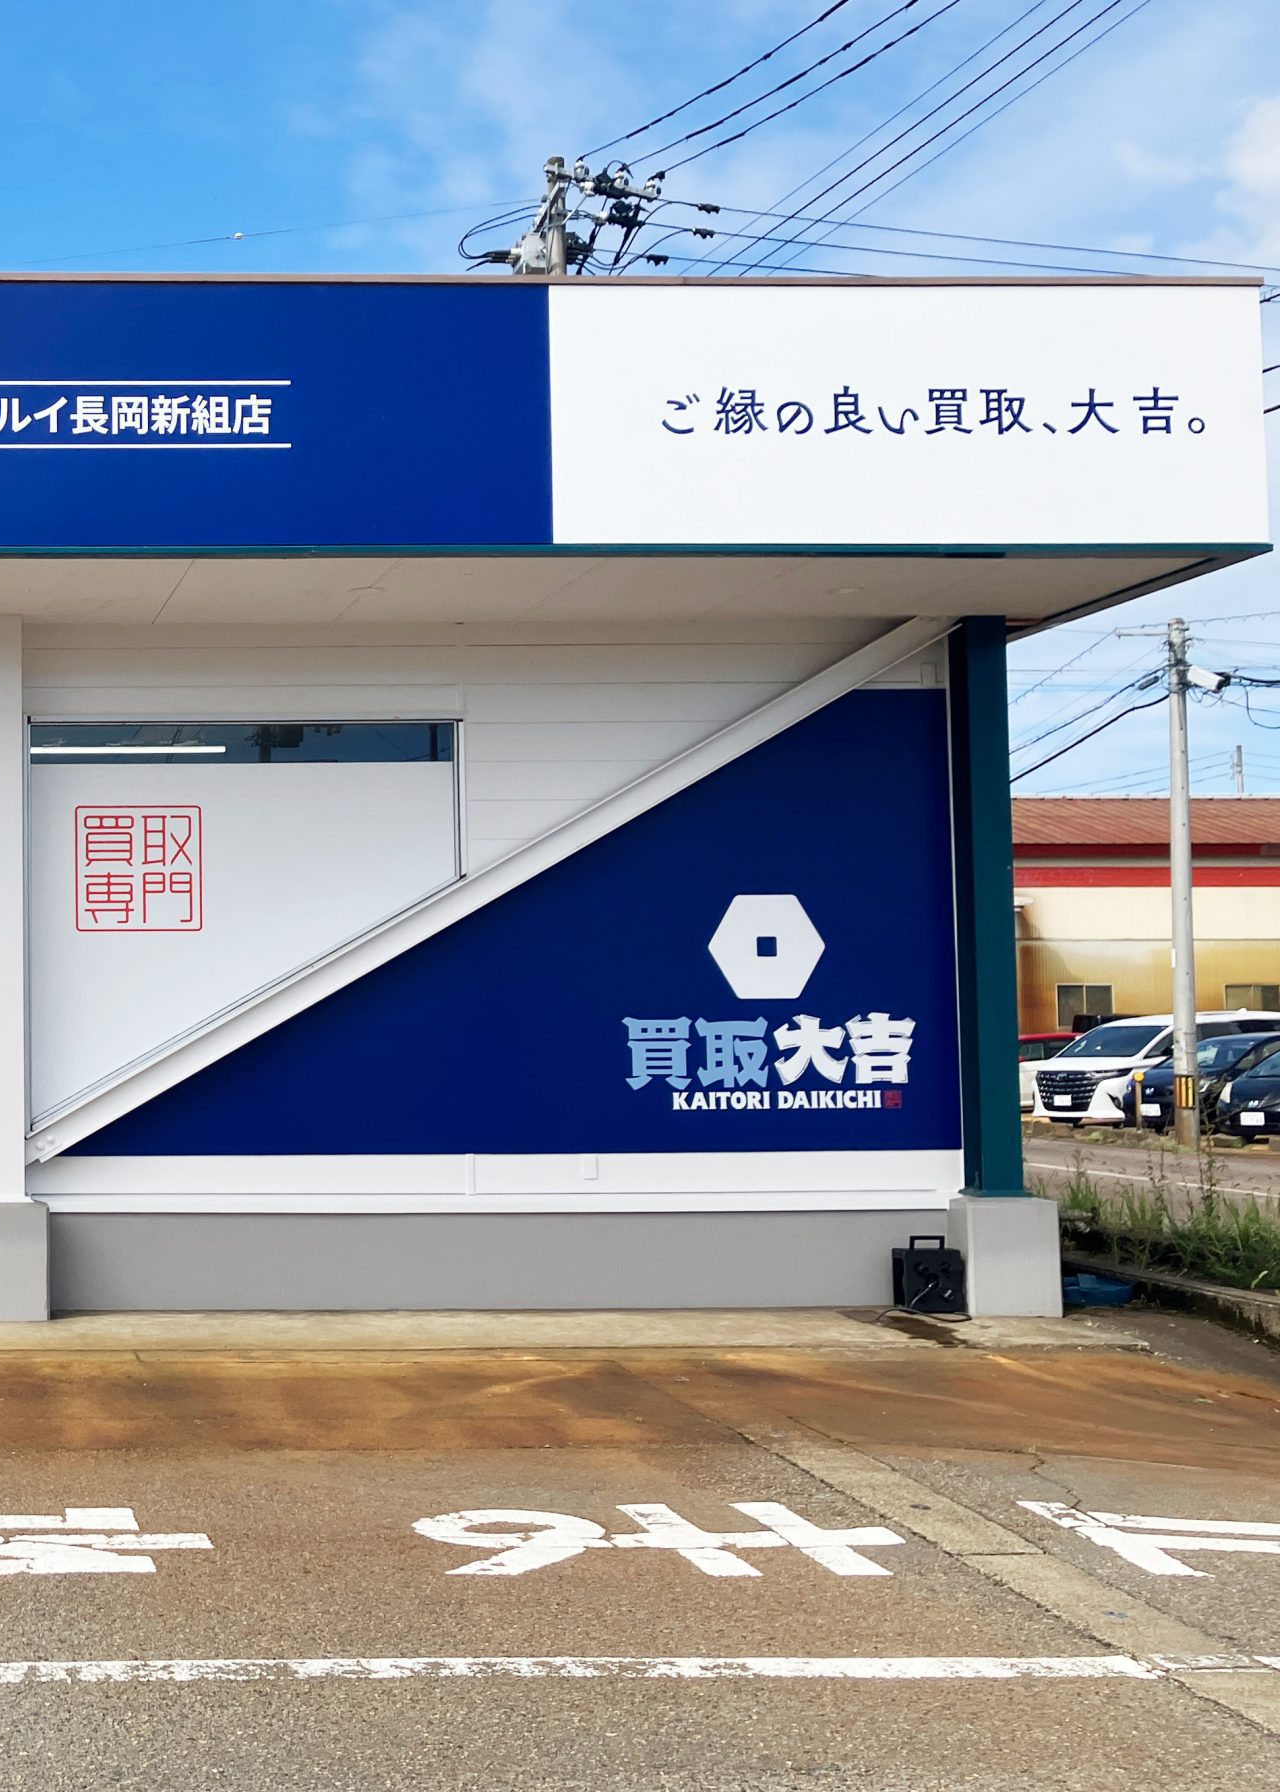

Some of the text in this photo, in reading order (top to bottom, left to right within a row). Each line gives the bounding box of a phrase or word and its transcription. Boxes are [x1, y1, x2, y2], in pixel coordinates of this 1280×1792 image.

[661, 386, 1207, 435] ご縁の良い買取、大吉。
[84, 815, 193, 867] 買取
[84, 872, 193, 924] 専門
[621, 1012, 917, 1090] 買取大吉
[672, 1091, 770, 1110] KAITORI
[777, 1090, 882, 1109] DAIKICHI
